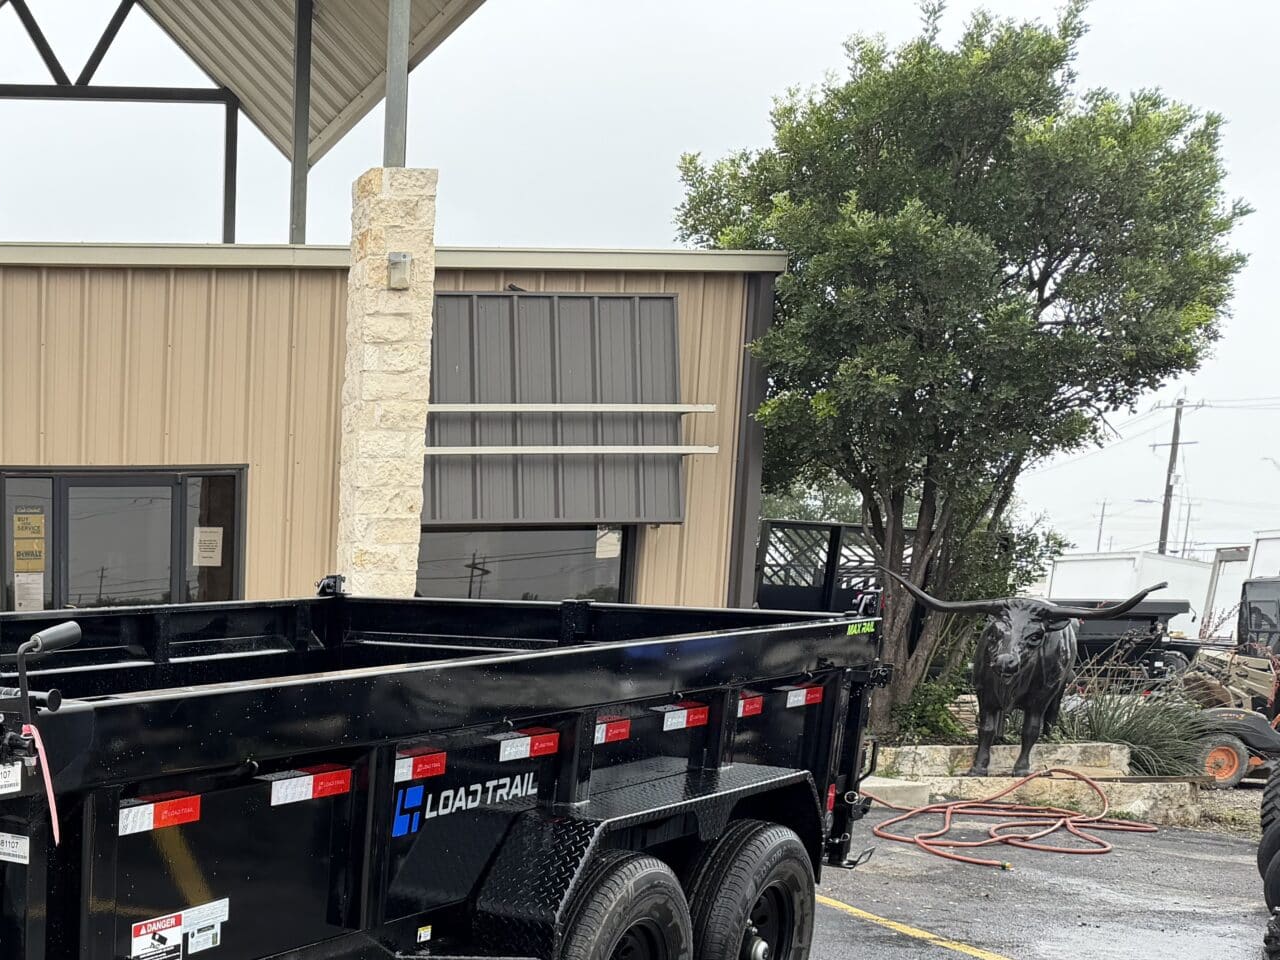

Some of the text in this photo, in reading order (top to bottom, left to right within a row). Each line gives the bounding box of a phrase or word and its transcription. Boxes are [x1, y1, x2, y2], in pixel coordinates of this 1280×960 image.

[425, 771, 538, 819] LOAD TRAIL
[146, 917, 176, 932] DANGER
